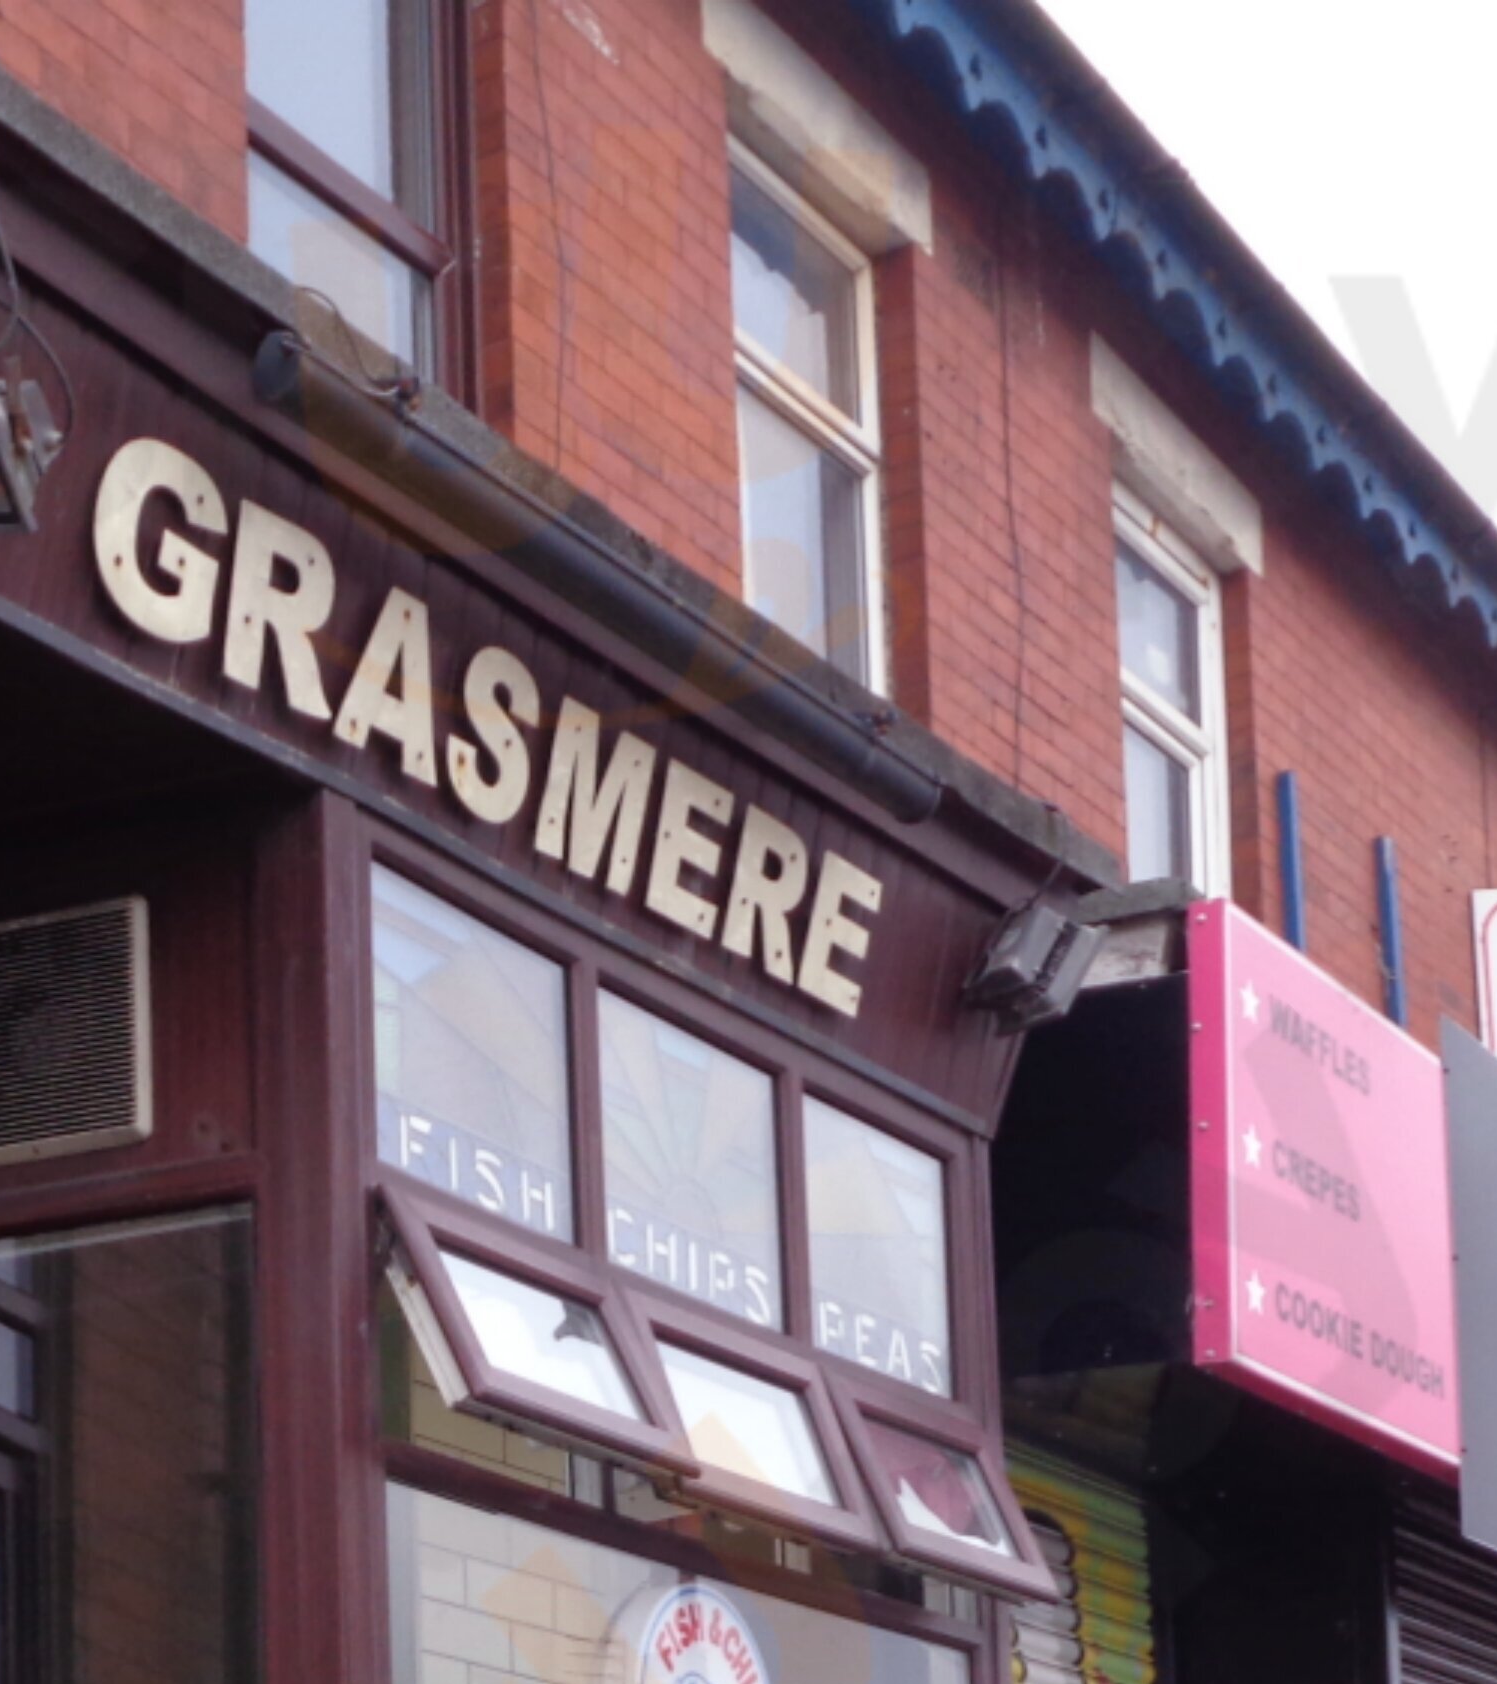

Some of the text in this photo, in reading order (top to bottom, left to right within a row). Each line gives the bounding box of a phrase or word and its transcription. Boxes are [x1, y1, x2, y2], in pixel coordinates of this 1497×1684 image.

[92, 436, 883, 1018] GRASMERE
[1268, 992, 1372, 1098] WAFFLES
[400, 1113, 556, 1231] FISH
[1271, 1138, 1361, 1224] CREPES
[607, 1208, 772, 1327] CHIPS
[819, 1299, 942, 1397] PEAS
[1274, 1281, 1445, 1400] COOKIE DOUGH
[656, 1603, 703, 1673] FISH
